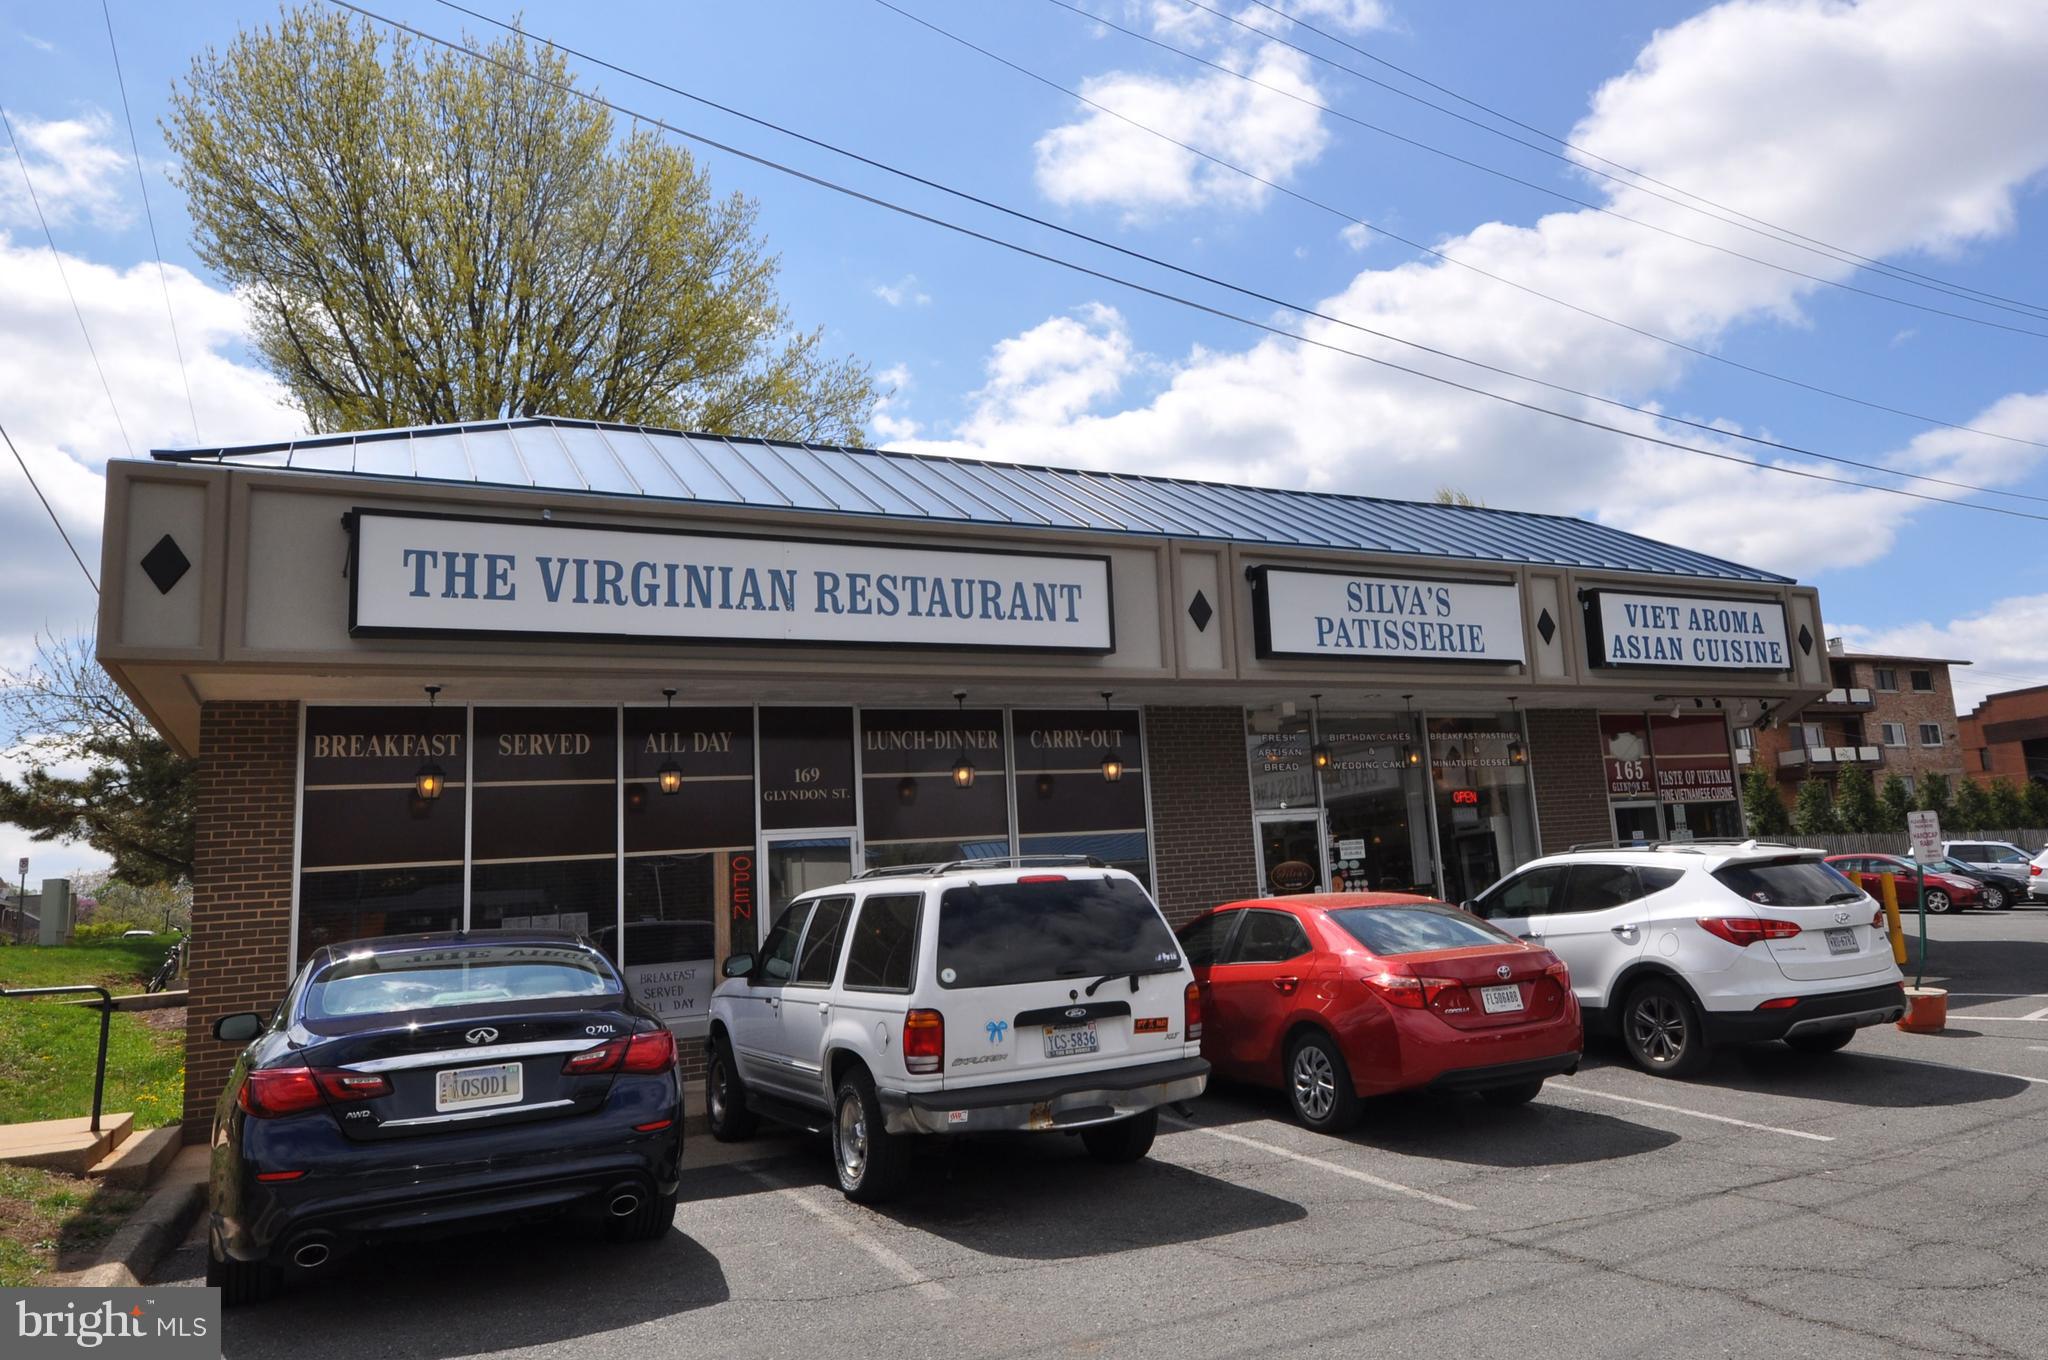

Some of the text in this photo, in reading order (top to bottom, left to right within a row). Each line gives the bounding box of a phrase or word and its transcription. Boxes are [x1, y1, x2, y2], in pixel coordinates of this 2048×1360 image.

[403, 549, 1082, 623] THE VIRGINIAN RESTAURANT
[1347, 581, 1451, 617] SILVA'S
[1624, 604, 1765, 634] VIET AROMA
[1314, 616, 1485, 653] PATISSERIE
[1612, 635, 1783, 664] ASIAN CUISINE
[644, 731, 733, 753] ALL DAY
[867, 730, 999, 751] LUNCH-DINNER
[1030, 729, 1124, 749] CARRY-OUT
[1261, 734, 1296, 742] FRESH
[1329, 732, 1411, 742] BIRTHDAY CAKES
[1430, 732, 1478, 740] BREAKFAST
[313, 734, 461, 758] BREAKFAST
[498, 733, 591, 756] SERVED
[1258, 748, 1302, 757] ARTISAN
[1264, 763, 1299, 771] BREAD
[1333, 761, 1379, 770] WEDDING
[1433, 759, 1478, 767] MINIATURE
[1614, 761, 1644, 780] 165
[795, 768, 821, 783] 169
[1659, 769, 1732, 785] TASTE OF VIETNAM
[763, 788, 851, 801] GLYNDON ST.
[1452, 790, 1478, 804] OPEN
[1711, 786, 1734, 800] CUISINE
[732, 856, 753, 920] OPEN
[640, 968, 696, 984] BREAKFAST
[644, 986, 684, 999] SERVED
[673, 998, 695, 1010] DAY
[585, 1025, 616, 1036] Q70L
[345, 1109, 369, 1119] AWD
